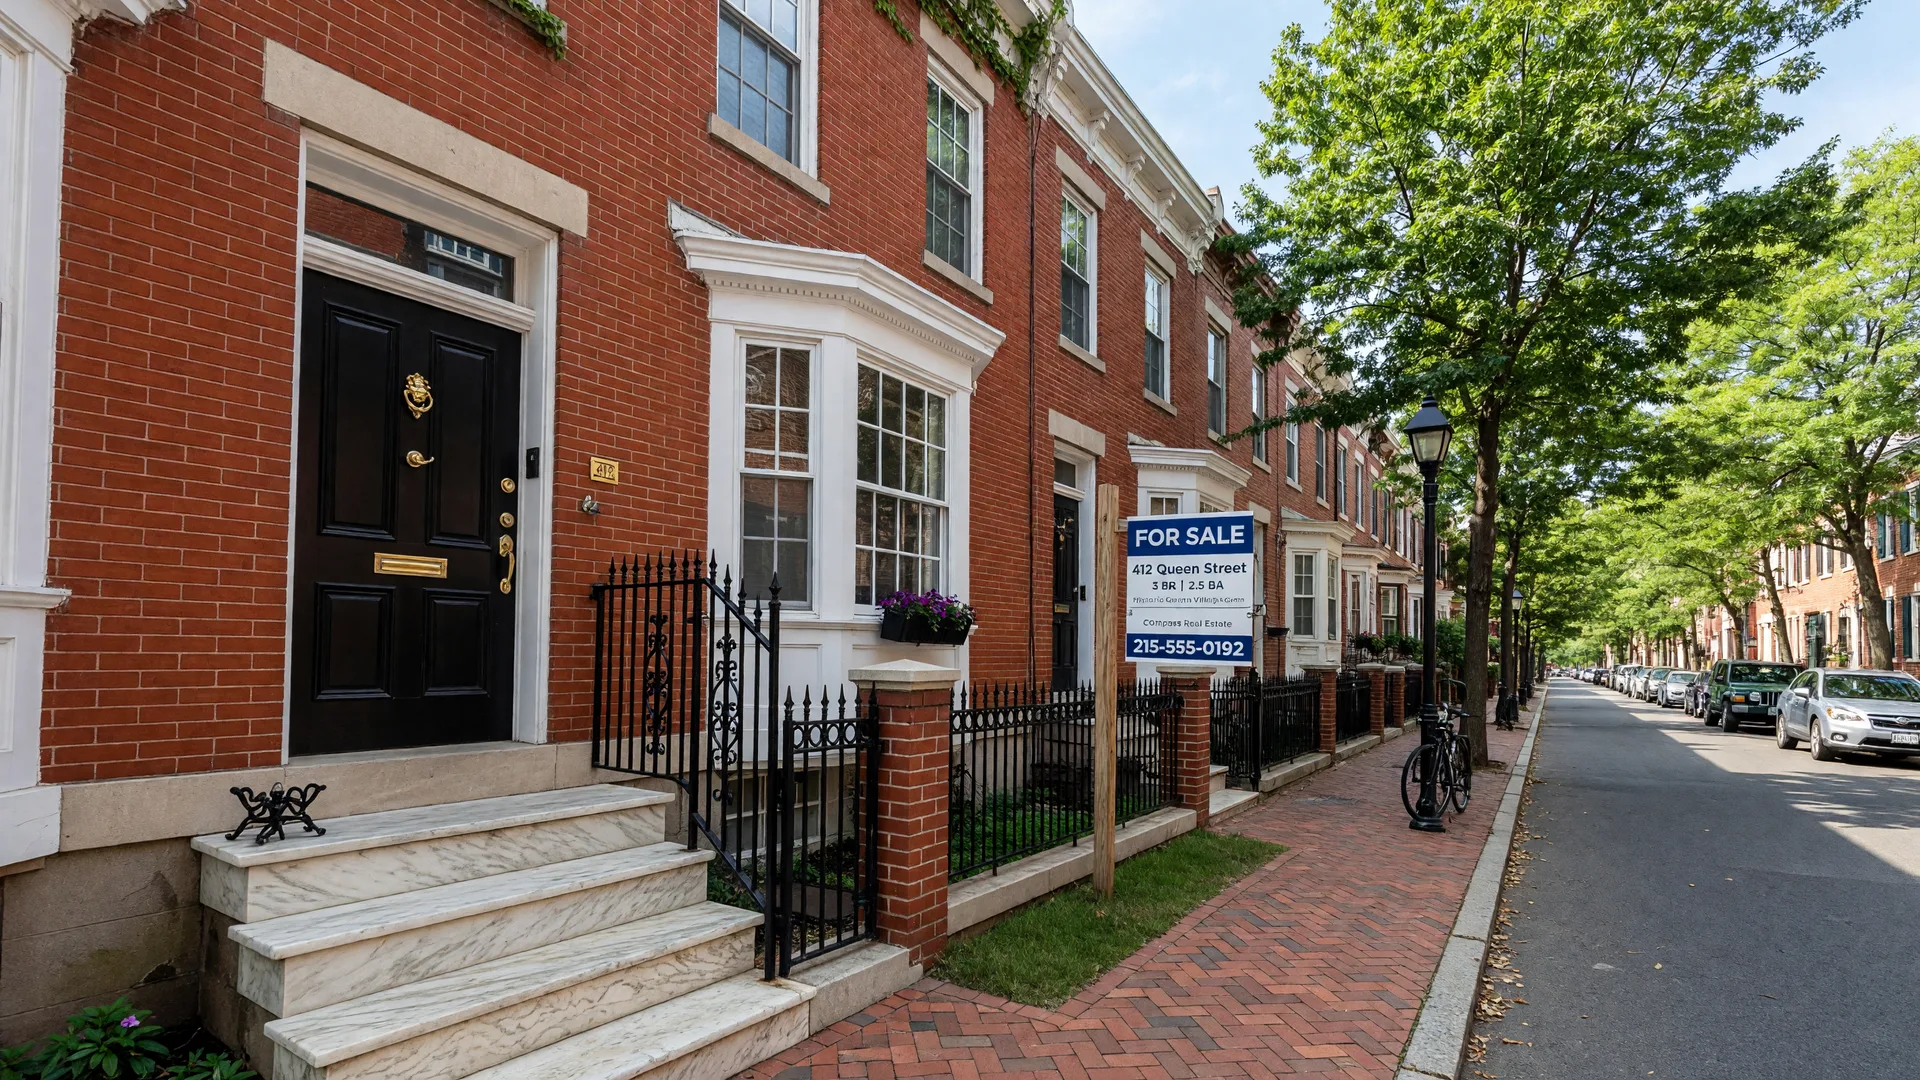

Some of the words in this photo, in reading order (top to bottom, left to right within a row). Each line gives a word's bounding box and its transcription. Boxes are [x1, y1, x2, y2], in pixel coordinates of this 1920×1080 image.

[1135, 528, 1180, 547] FOR
[1185, 525, 1245, 546] SALE
[1132, 564, 1153, 575] 412
[1156, 563, 1200, 575] Queen
[1203, 562, 1247, 574] Street
[1152, 581, 1159, 590] 3
[1162, 581, 1176, 590] BR
[1188, 581, 1205, 590] 2.5
[1208, 581, 1224, 590] BA
[1142, 619, 1182, 628] Compass
[1204, 619, 1233, 628] Estate
[1133, 638, 1244, 657] 215-555-0192
